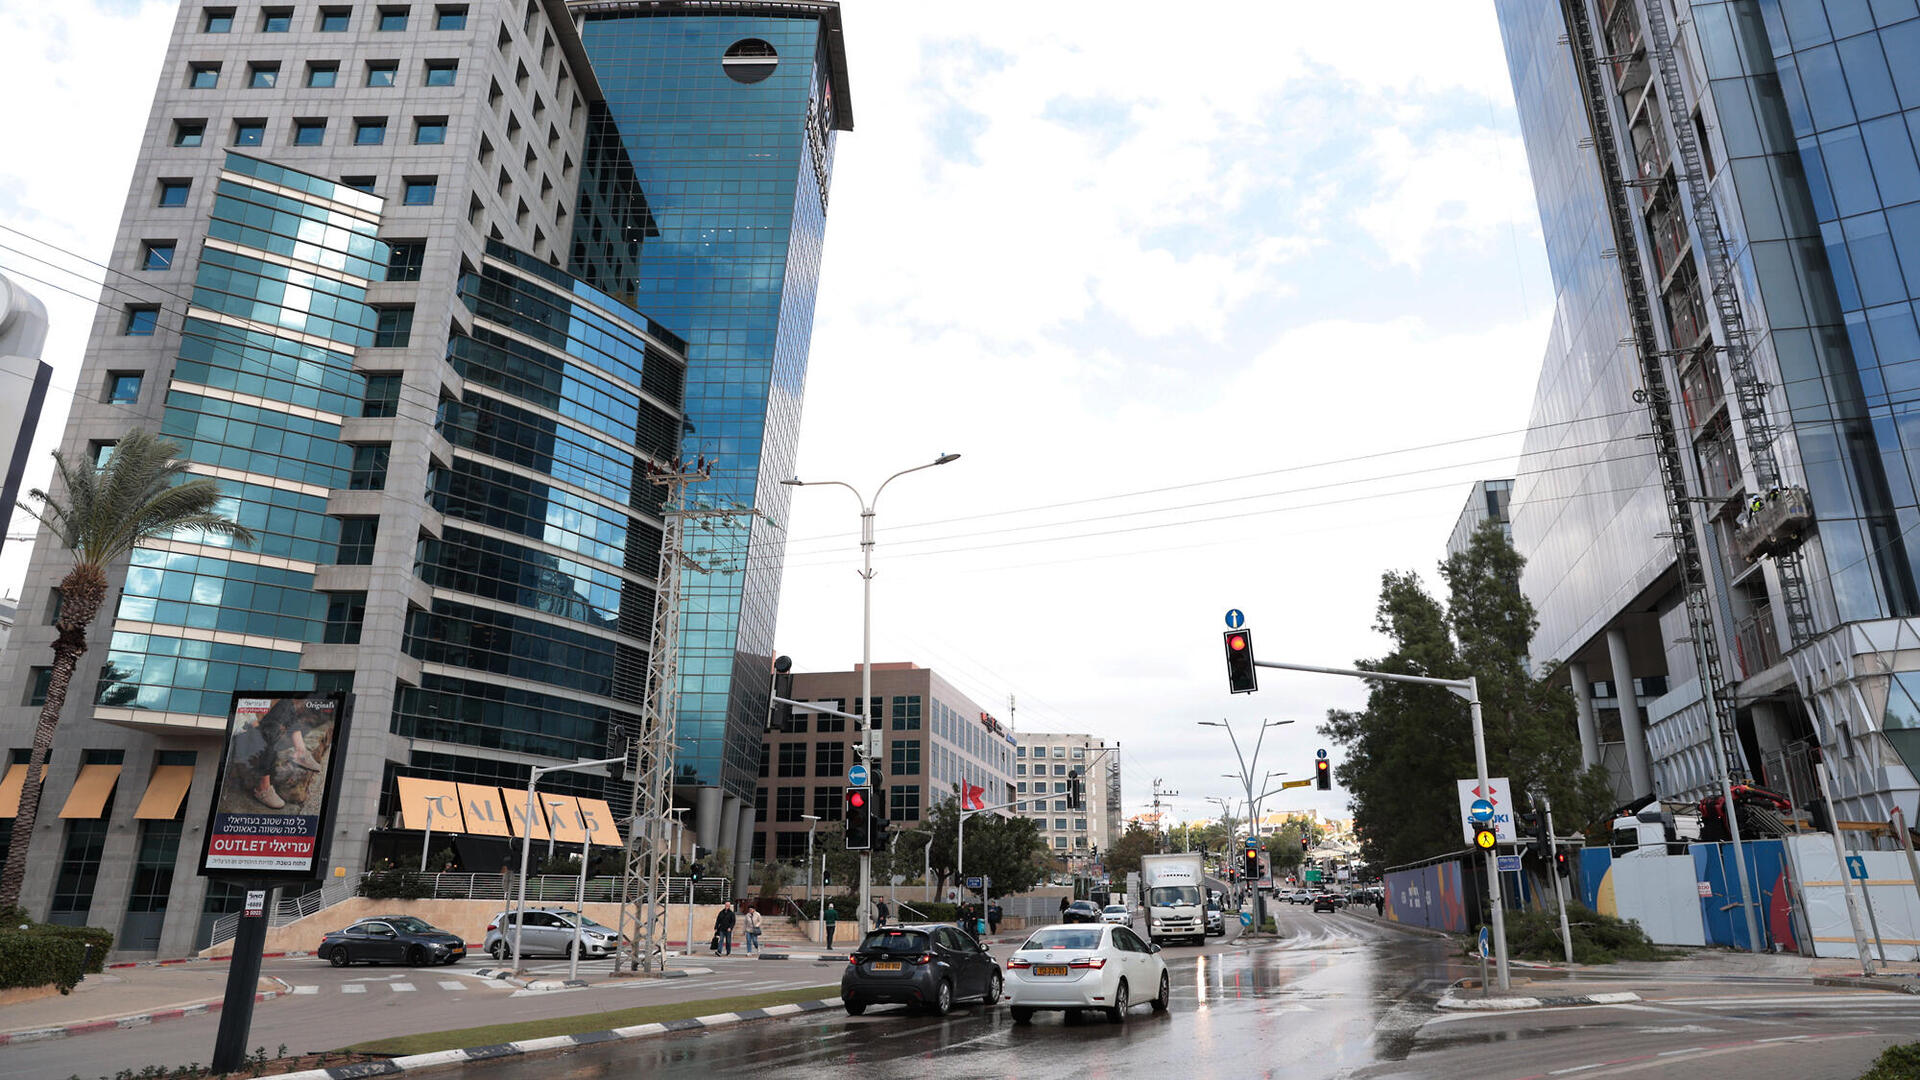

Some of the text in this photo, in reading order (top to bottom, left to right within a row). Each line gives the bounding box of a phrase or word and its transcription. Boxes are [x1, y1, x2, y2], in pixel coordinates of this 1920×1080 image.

[228, 816, 260, 825] בעזריאלי
[262, 817, 281, 825] שטוב
[297, 817, 306, 826] כל
[284, 826, 296, 834] מה
[298, 826, 307, 834] כל
[214, 839, 311, 853] עזריאלי OUTLET
